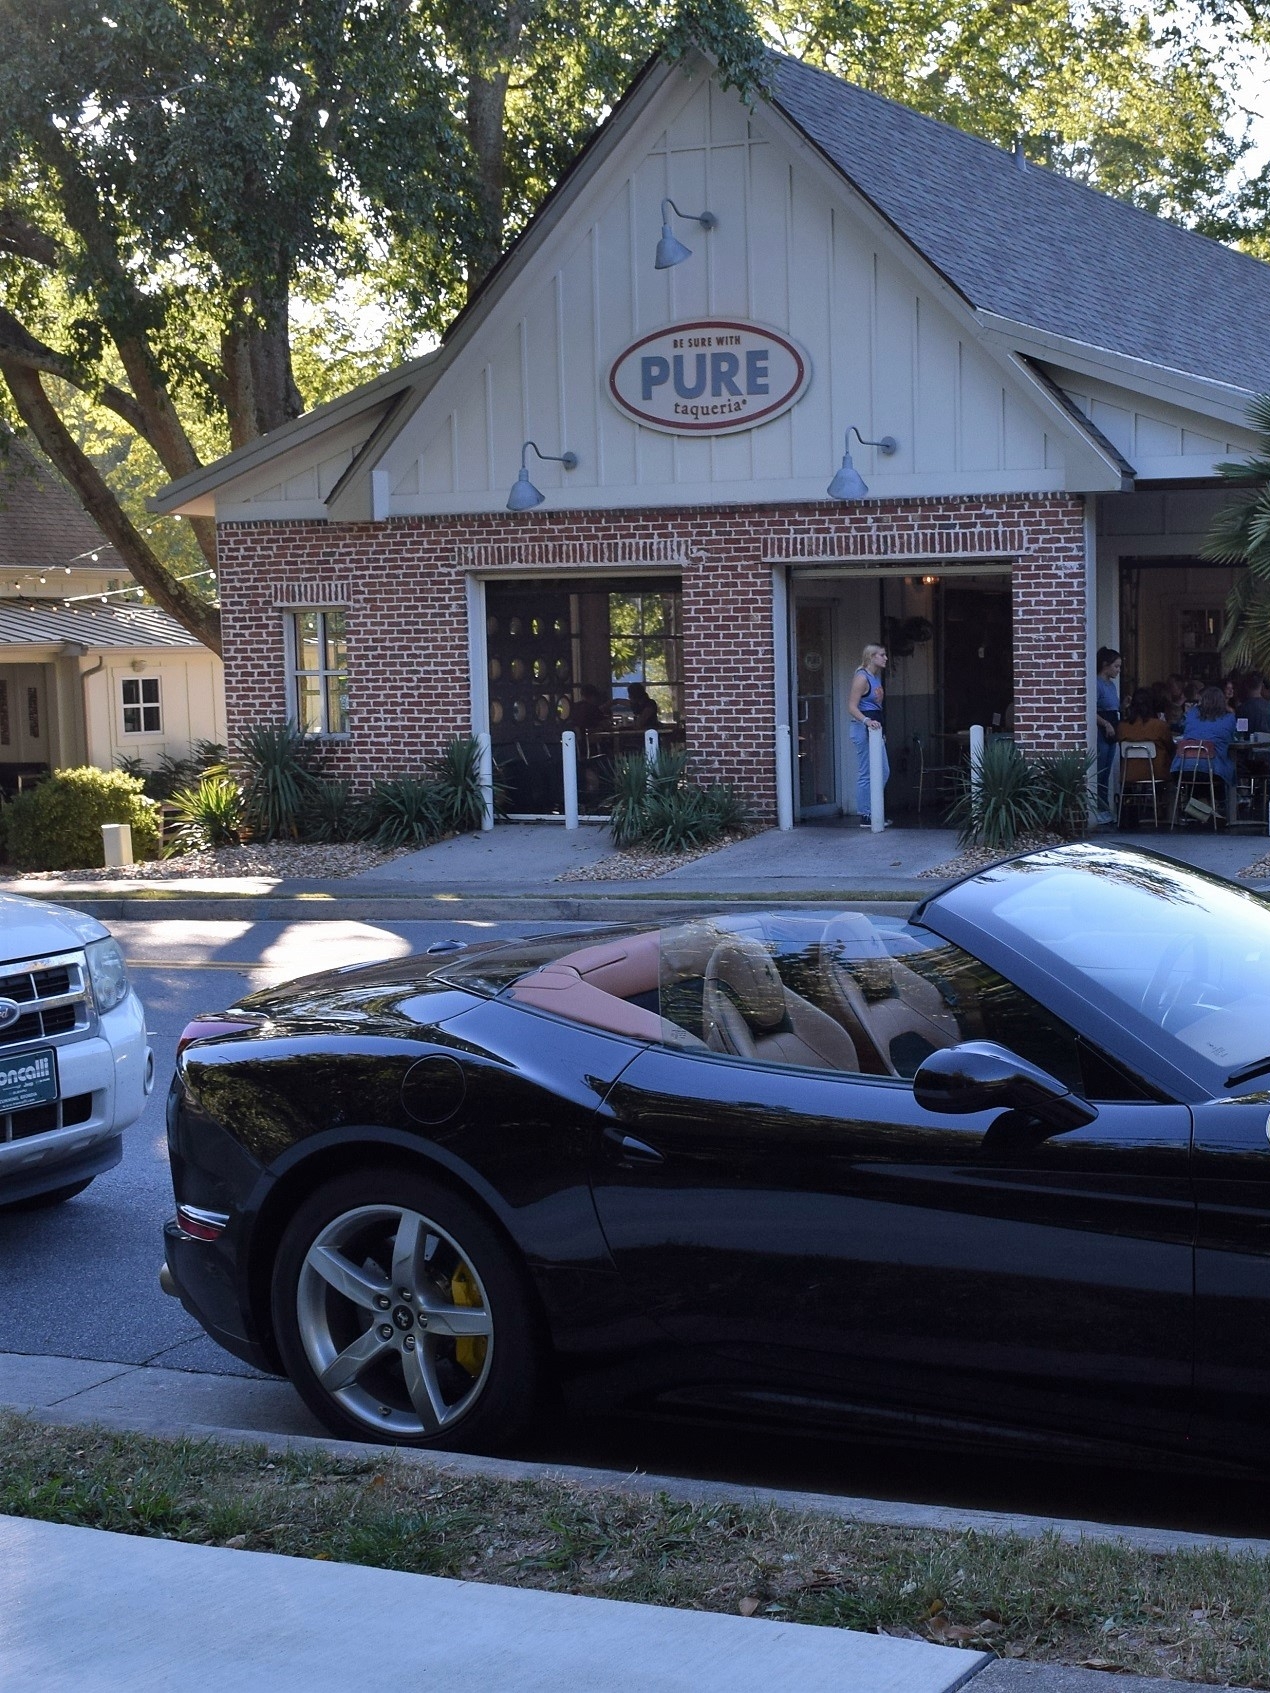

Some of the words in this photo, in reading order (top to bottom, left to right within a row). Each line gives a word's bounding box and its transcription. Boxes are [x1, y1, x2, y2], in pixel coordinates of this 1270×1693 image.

[673, 339, 684, 349] BE
[688, 337, 712, 348] SURE
[716, 335, 741, 346] WITH
[641, 350, 769, 401] PURE
[674, 398, 742, 420] taqueria
